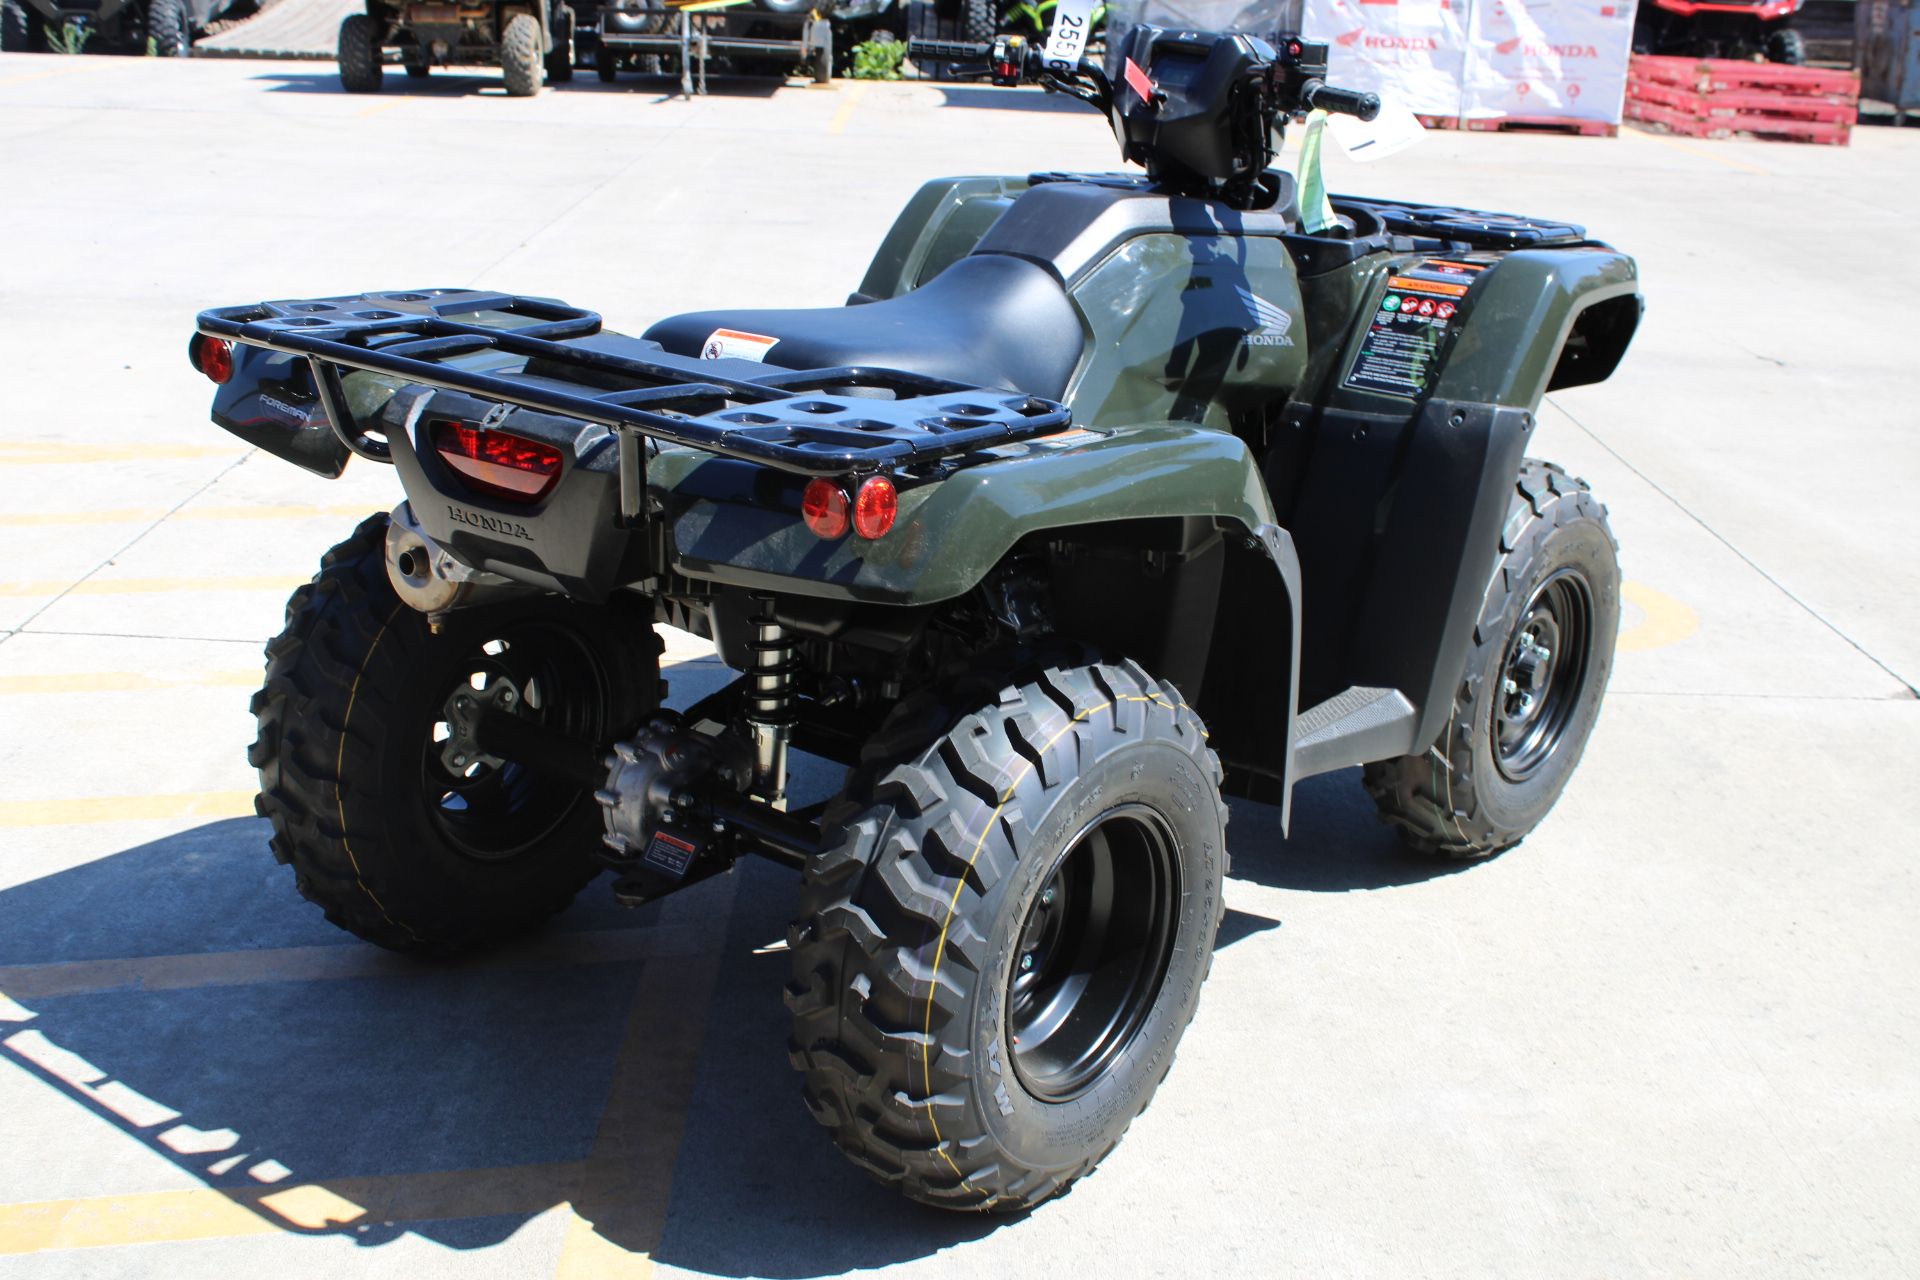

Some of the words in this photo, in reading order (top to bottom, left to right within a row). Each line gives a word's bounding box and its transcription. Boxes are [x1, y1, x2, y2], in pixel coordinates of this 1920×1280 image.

[1364, 35, 1438, 50] HONDA
[1523, 44, 1598, 58] HONDA
[1241, 335, 1295, 346] HONDA
[259, 394, 312, 423] FOREMAN
[447, 505, 535, 541] HONDA
